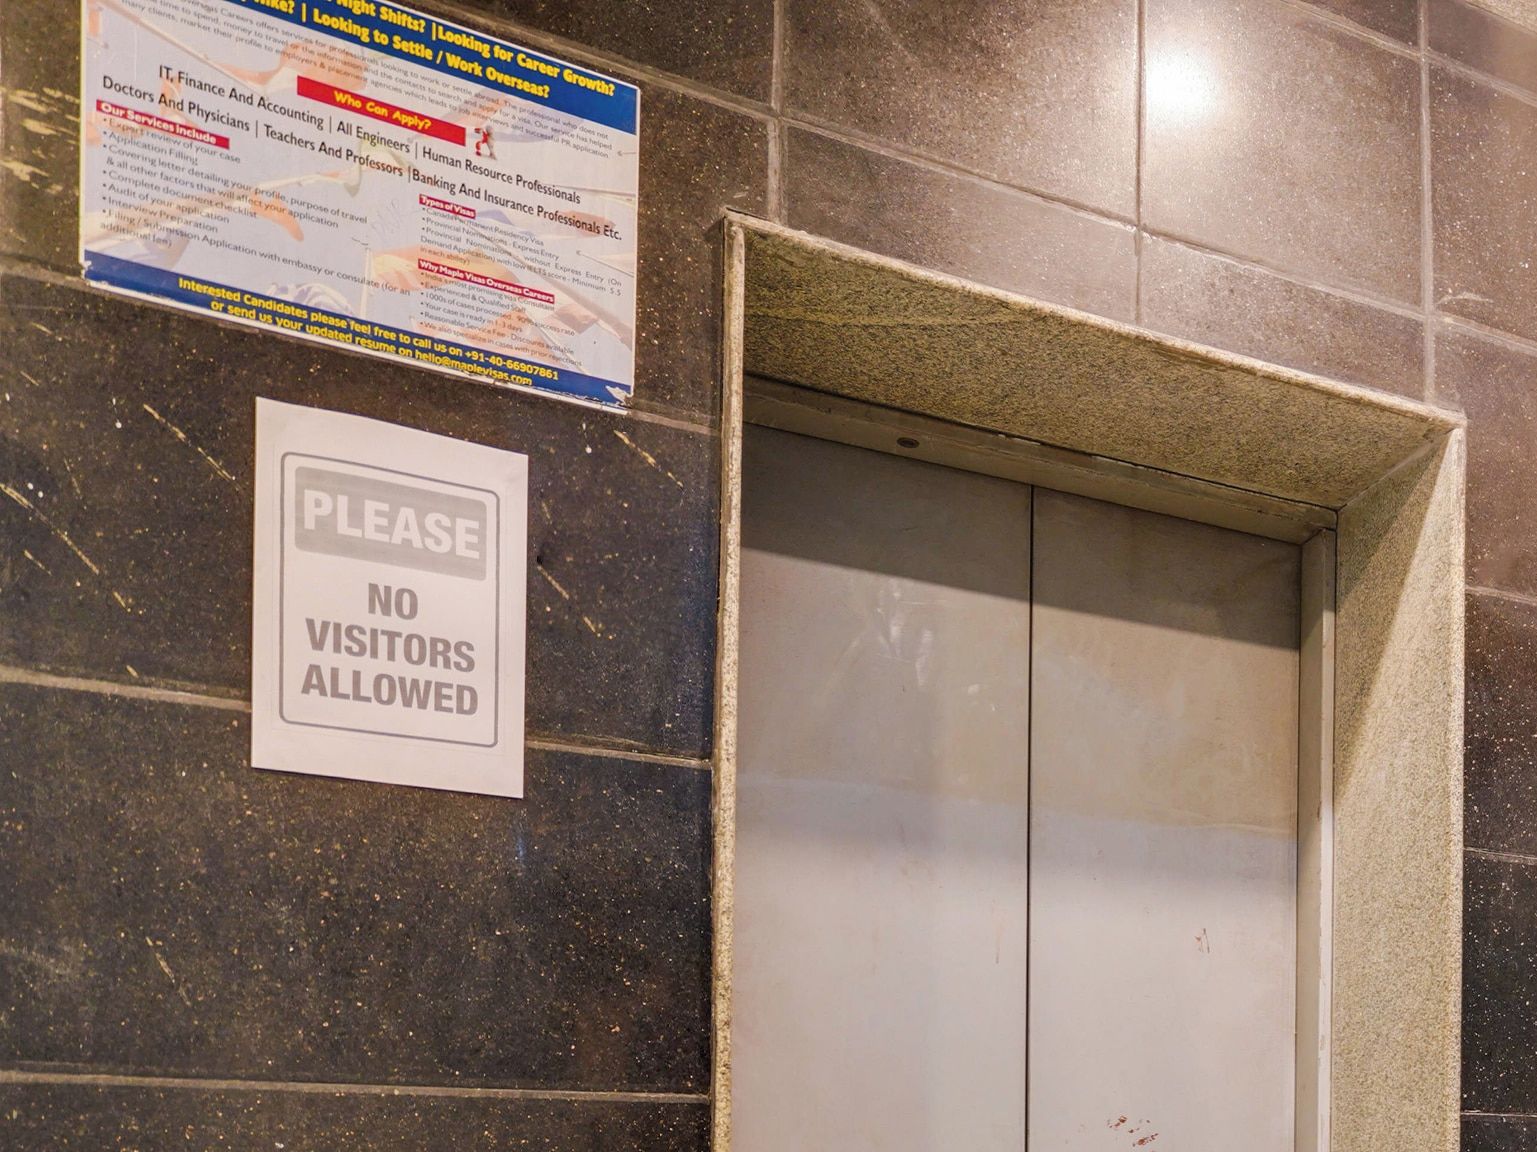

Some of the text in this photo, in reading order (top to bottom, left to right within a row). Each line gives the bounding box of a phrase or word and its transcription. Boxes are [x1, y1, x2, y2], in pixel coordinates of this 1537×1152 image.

[313, 7, 369, 43] Looking
[373, 28, 388, 45] to
[392, 33, 432, 60] Settle
[445, 52, 482, 77] Work
[485, 65, 549, 99] Overseas?
[379, 5, 425, 34] Shifts?
[493, 44, 513, 63] for
[516, 51, 560, 79] Career
[563, 67, 614, 97] Growth?
[101, 102, 125, 117] Our
[127, 109, 173, 132] Services
[334, 90, 431, 131] Who Can Apply?
[109, 130, 167, 154] Application
[146, 132, 179, 146] review
[183, 141, 193, 150] of
[195, 145, 216, 156] your
[219, 152, 240, 163] case
[159, 64, 173, 83] IT,
[178, 69, 224, 97] Finance
[229, 85, 252, 106] And
[257, 95, 323, 131] Accounting
[337, 119, 352, 135] All
[356, 125, 409, 153] Engineers
[422, 145, 461, 168] Human
[465, 158, 512, 184] Resource
[516, 173, 580, 204] Professionals
[102, 74, 153, 102] Doctors
[158, 92, 183, 111] And
[188, 101, 249, 132] Physicians
[264, 123, 314, 151] Teachers
[318, 140, 341, 159] And
[346, 148, 402, 177] Professors
[459, 182, 480, 199] And
[484, 189, 533, 215] Insurance
[537, 205, 600, 234] Professionals
[604, 224, 621, 240] Etc.
[108, 144, 367, 224] Covering letter detailing your profile, purpose of travel
[108, 182, 229, 223] Audit of your application
[109, 170, 256, 219] Complete document checklist
[117, 161, 127, 169] all
[129, 165, 156, 177] other
[160, 171, 193, 188] factors
[196, 181, 215, 194] that
[217, 189, 234, 199] will
[236, 194, 262, 207] affect
[264, 202, 288, 214] your
[288, 209, 338, 227] application
[108, 196, 217, 232] Interview Preparation
[420, 195, 443, 208] Types
[454, 205, 474, 217] Visas
[144, 219, 199, 240] Submission
[201, 234, 256, 255] Application
[260, 252, 279, 262] with
[282, 258, 321, 275] embassy
[324, 268, 334, 276] or
[336, 273, 379, 288] consulate
[381, 282, 397, 292] (for
[400, 288, 410, 296] an
[541, 248, 559, 261] Entry
[555, 263, 581, 275] Express
[585, 271, 603, 283] Entry
[419, 260, 553, 302] Why Maple Visas Overseas Careers
[572, 277, 605, 292] Minimum
[442, 307, 457, 315] case
[466, 314, 485, 323] ready
[456, 301, 474, 310] cases
[178, 277, 558, 380] Interested Candidates please feel free to call us on +91-40-66907861
[211, 300, 532, 385] or send us your updated resume on hello@maplevisas.com
[304, 490, 480, 559] PLEASE
[368, 583, 418, 620] NO
[305, 618, 475, 673] VISITORS
[301, 665, 478, 716] ALLOWED
